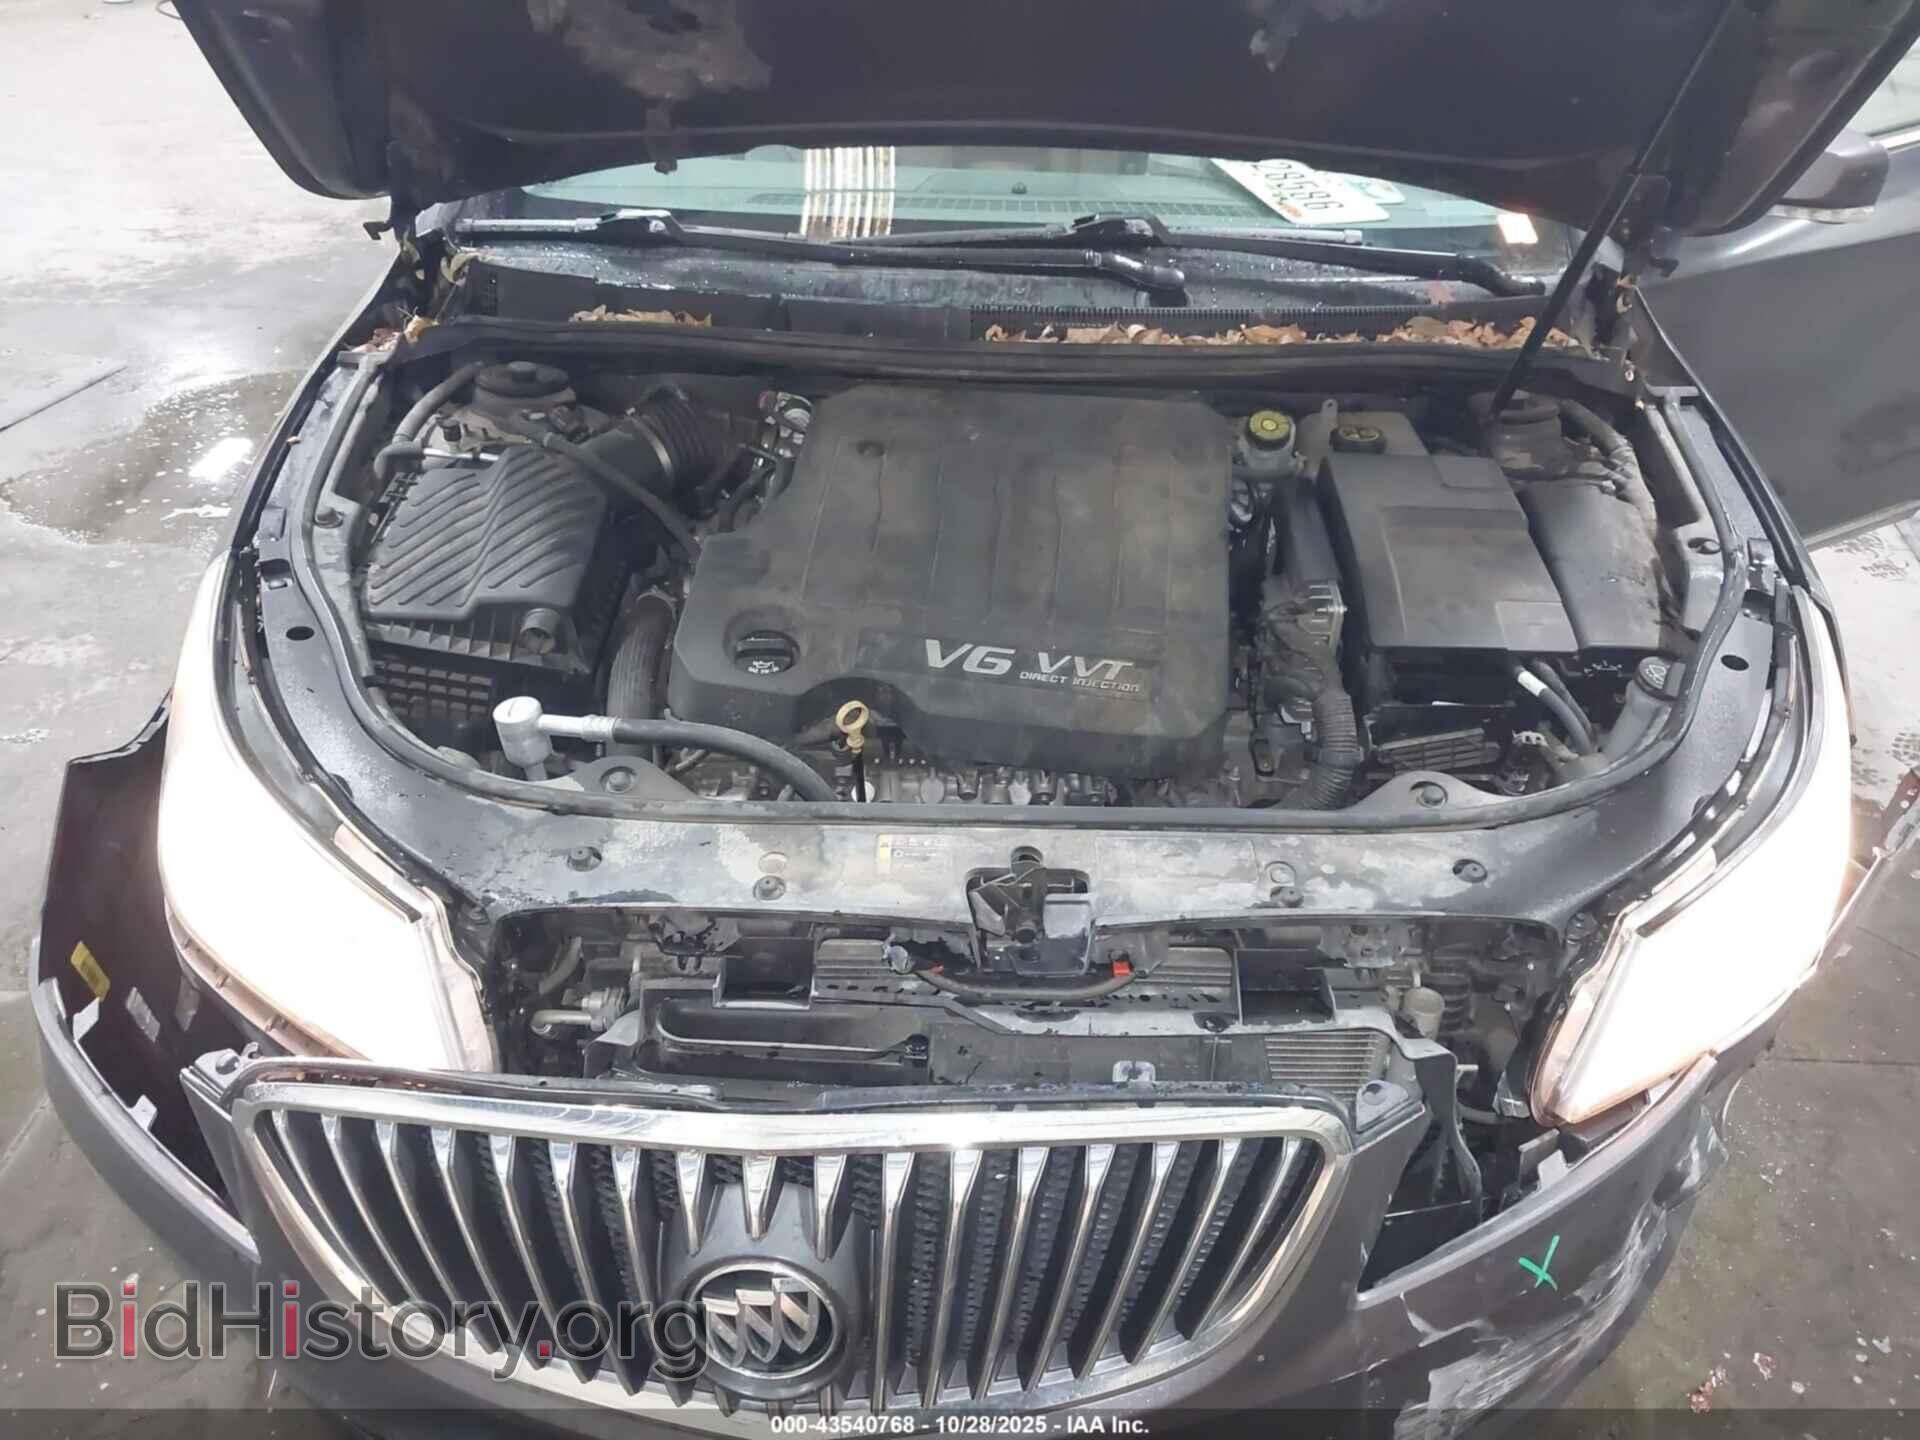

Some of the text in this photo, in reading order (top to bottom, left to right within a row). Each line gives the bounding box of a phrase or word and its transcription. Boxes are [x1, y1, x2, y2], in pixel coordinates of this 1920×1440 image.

[926, 639, 1134, 680] V6 VVT
[1019, 671, 1141, 692] DIRECT INJECTION
